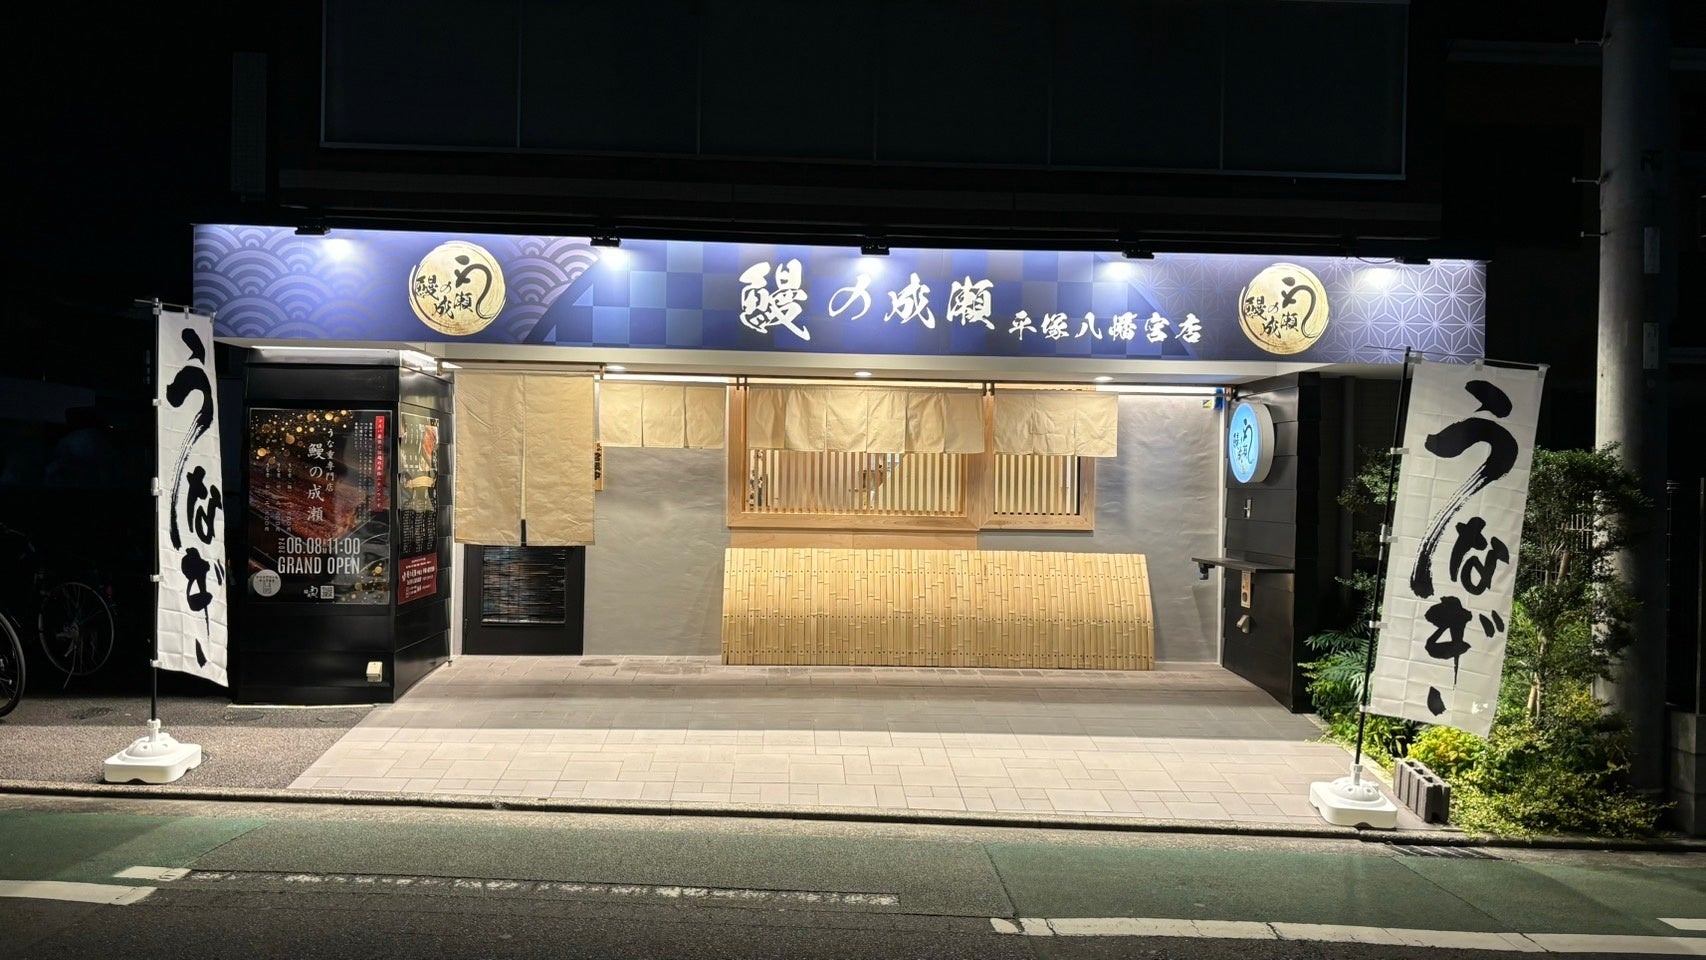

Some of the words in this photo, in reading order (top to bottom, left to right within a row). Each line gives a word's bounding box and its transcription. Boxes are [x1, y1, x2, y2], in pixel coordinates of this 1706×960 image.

[415, 274, 474, 320] 鰻の成瀬
[738, 258, 996, 341] 鰻の成瀬
[1008, 310, 1203, 345] 平塚八幡宮店
[1245, 295, 1299, 340] 鰻の成瀬
[306, 442, 326, 523] 鰻の成瀬
[325, 428, 336, 492] うな重専門店
[166, 327, 224, 669] うなぎ
[277, 556, 322, 574] GRAND
[327, 556, 360, 575] OPEN
[286, 537, 322, 554] 06.08
[327, 537, 361, 555] 11:00
[1409, 379, 1519, 717] うなぎ
